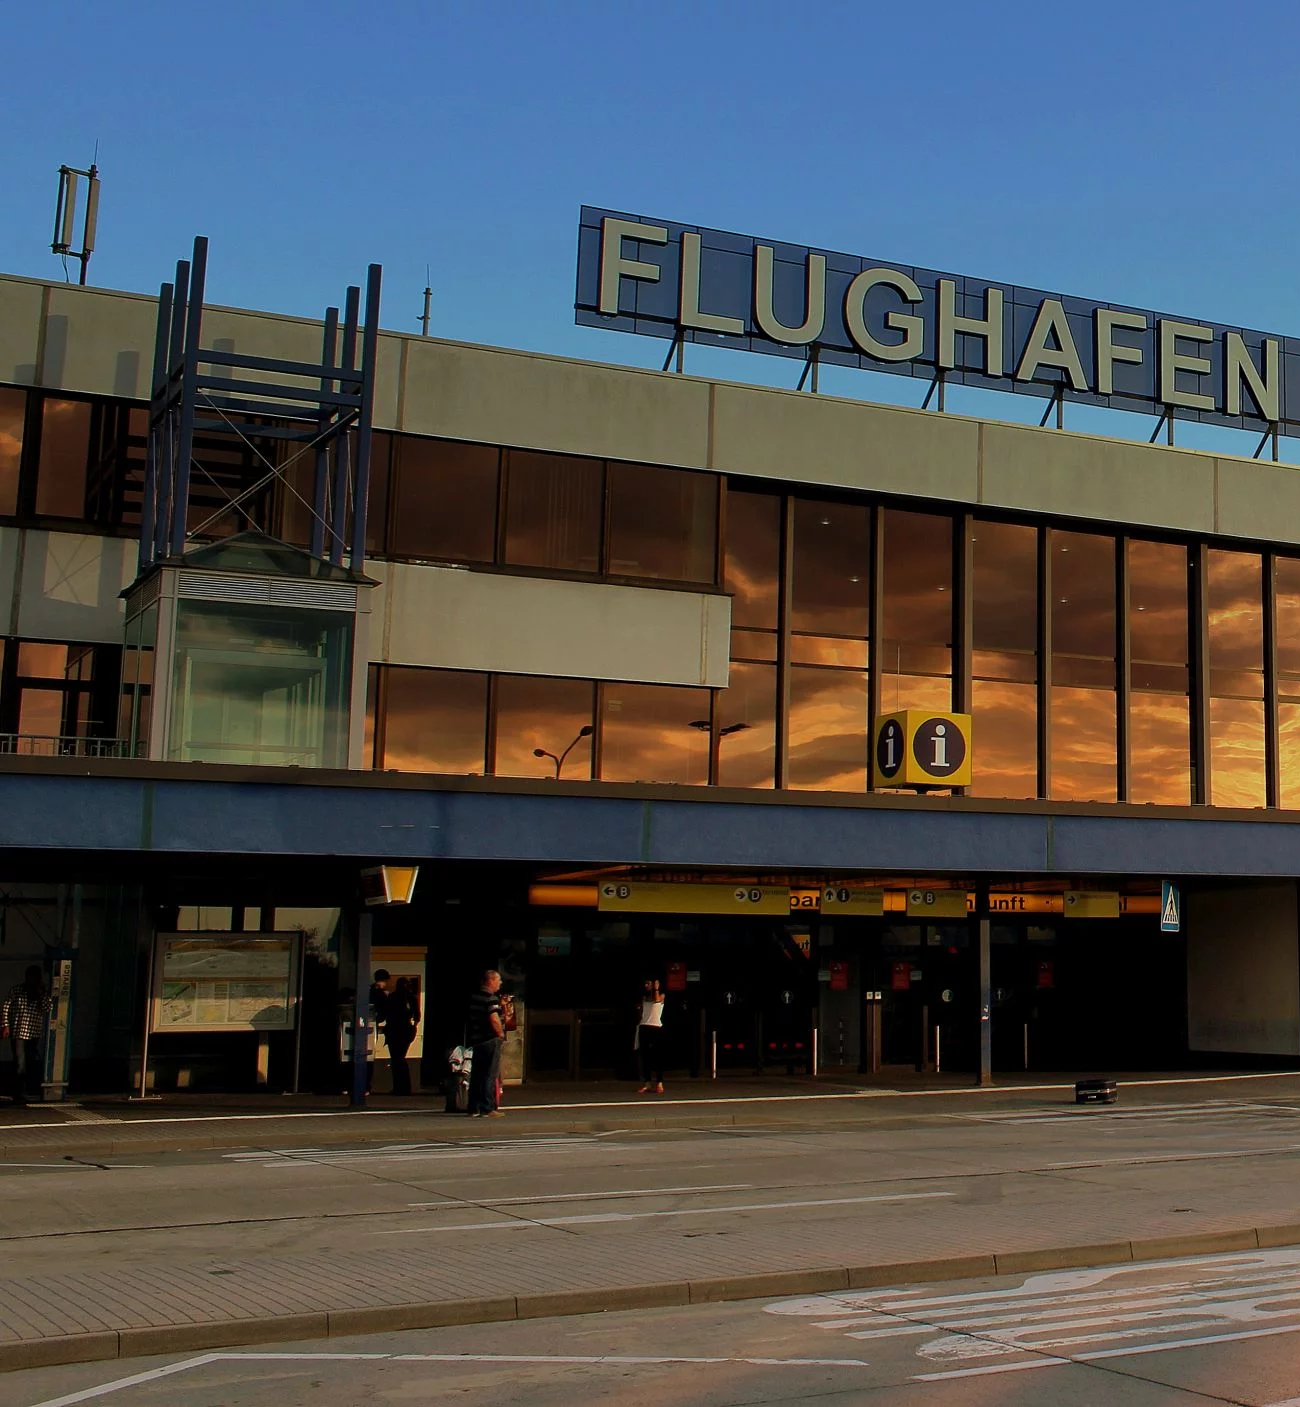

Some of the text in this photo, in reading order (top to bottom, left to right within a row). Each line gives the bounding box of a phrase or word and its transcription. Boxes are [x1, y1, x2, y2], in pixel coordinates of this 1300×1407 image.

[597, 215, 1280, 422] FLUGHAFEN
[619, 886, 629, 897] B
[750, 890, 761, 901] D
